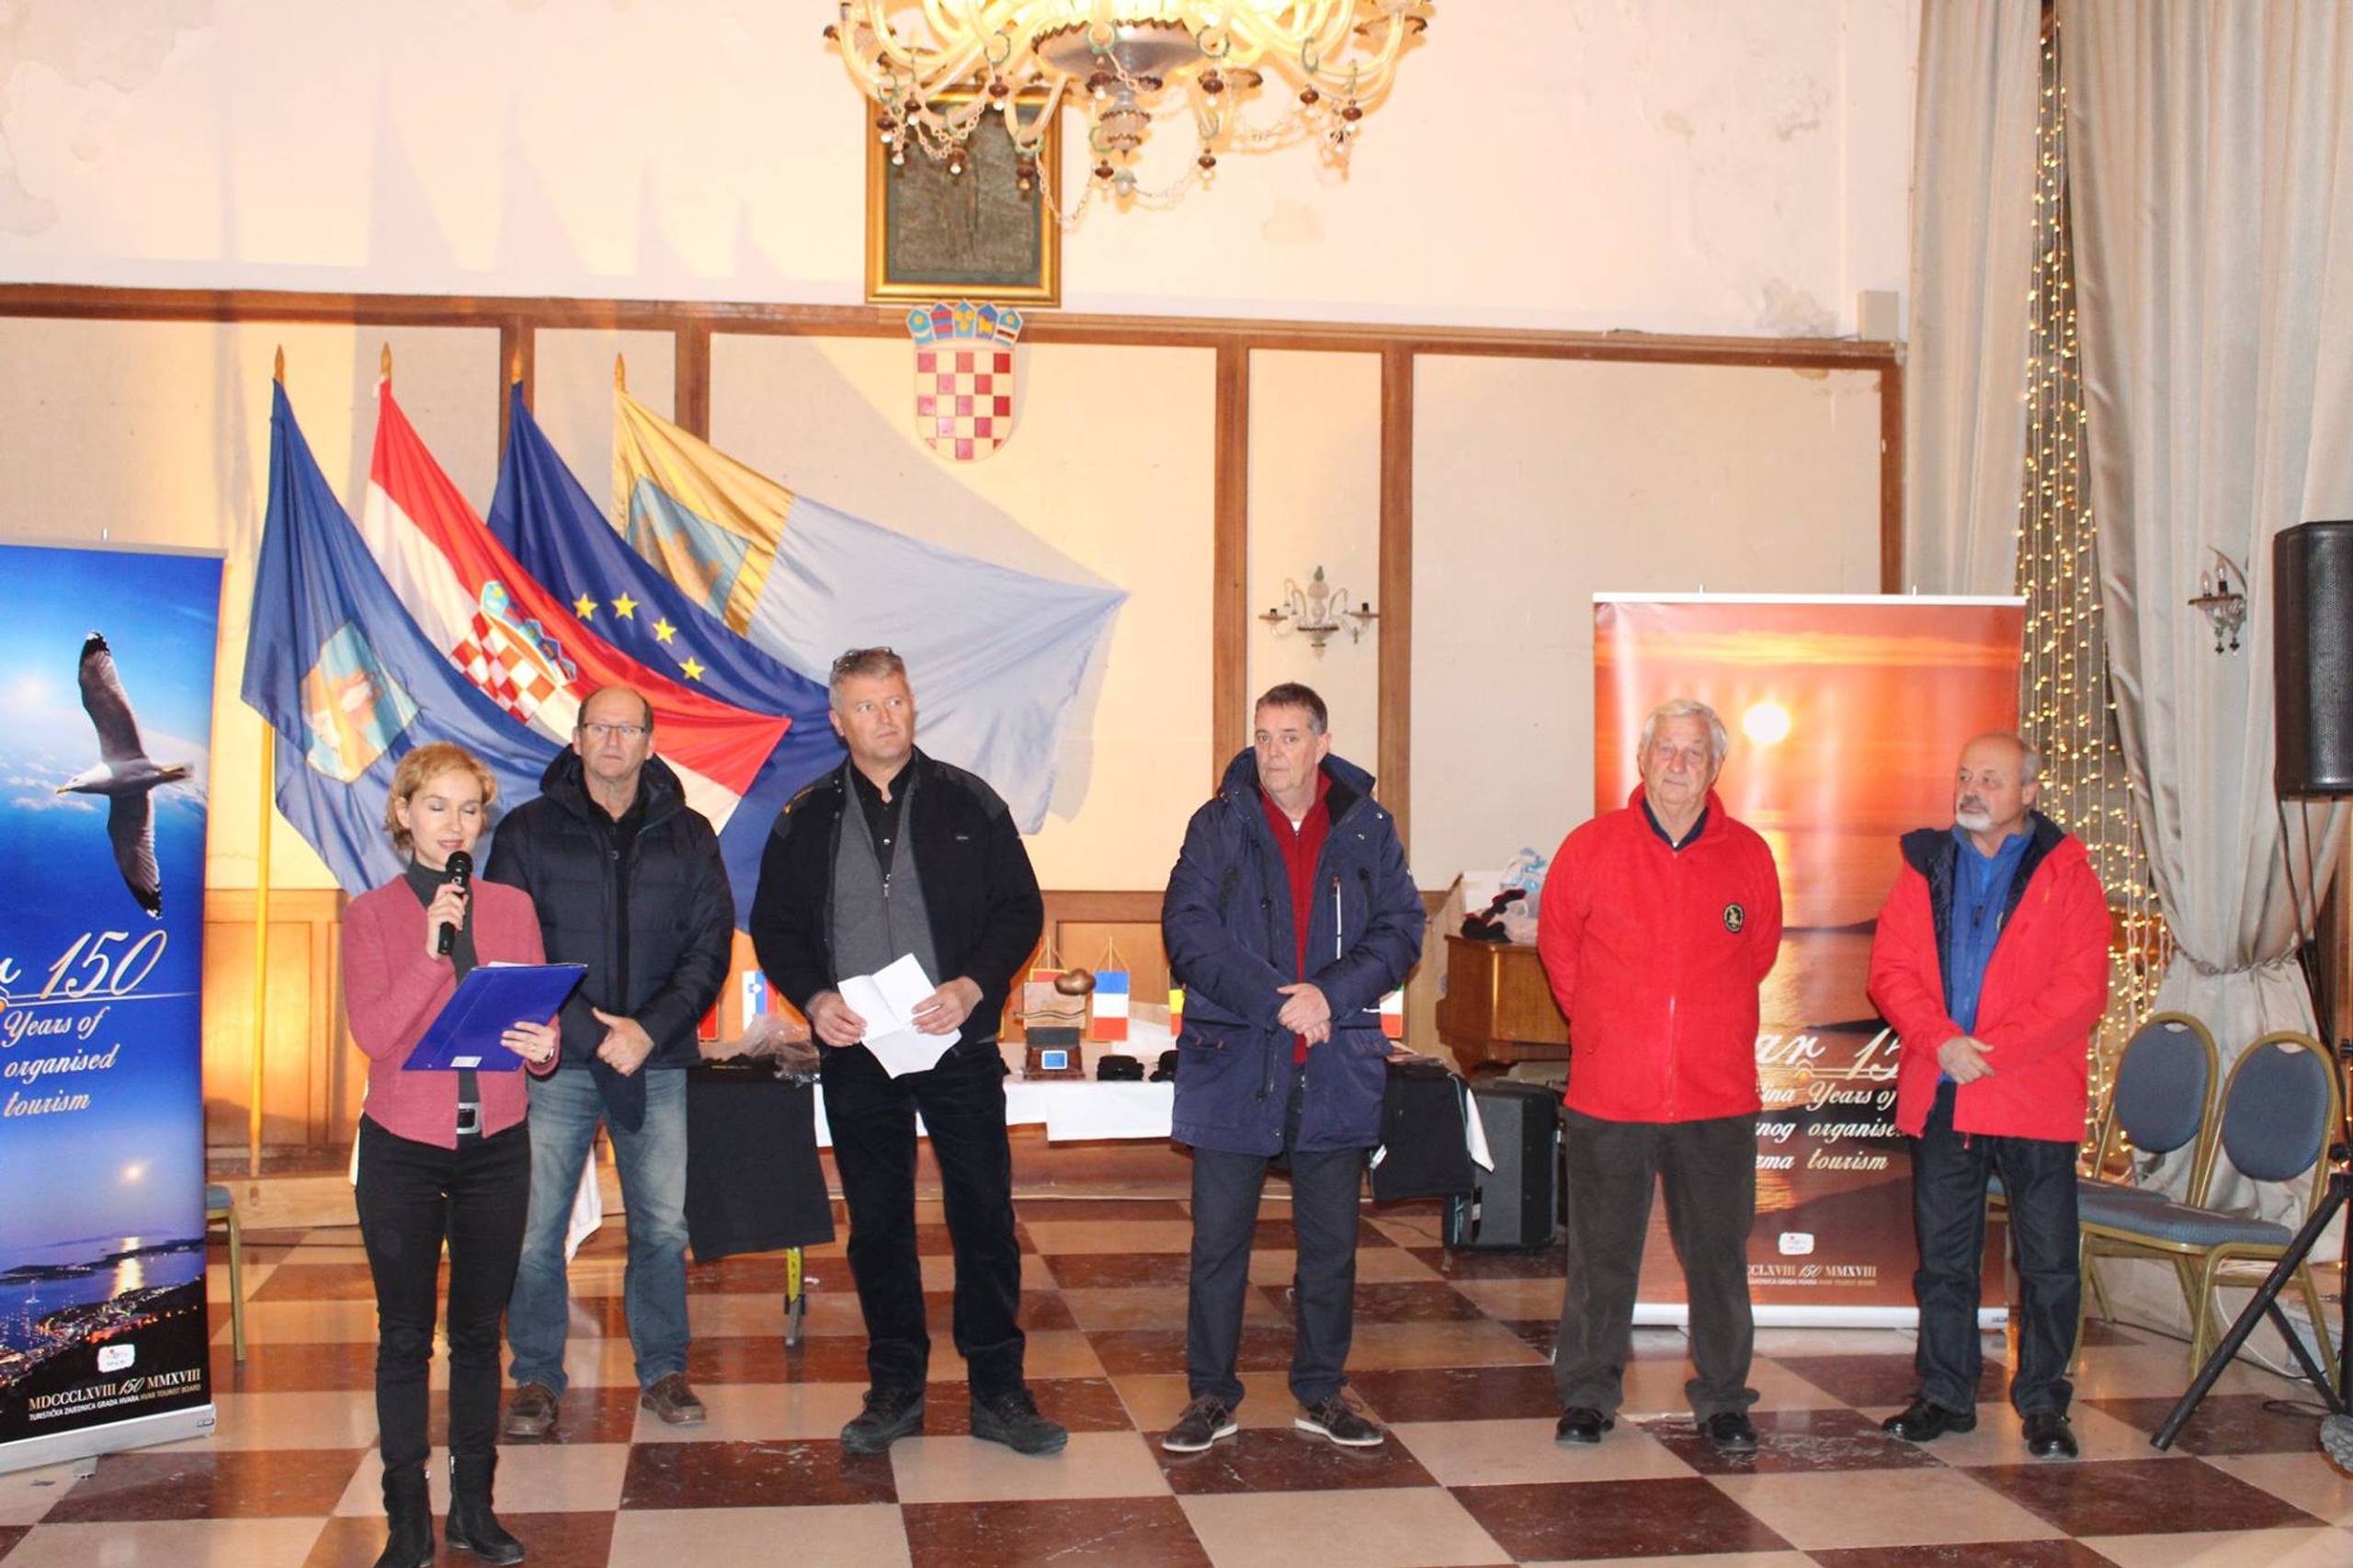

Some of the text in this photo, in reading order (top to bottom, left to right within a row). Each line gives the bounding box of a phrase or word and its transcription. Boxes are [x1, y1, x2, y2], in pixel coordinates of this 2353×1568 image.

[40, 929, 168, 999] 150
[2, 1006, 111, 1048] Years of
[4, 1043, 120, 1085] organised
[4, 1089, 90, 1118] tourism
[1805, 1080, 1872, 1112] Years
[1808, 1118, 1903, 1143] organise
[1807, 1147, 1890, 1170] tourism
[118, 1376, 145, 1396] 150
[147, 1368, 201, 1390] MMXVIII
